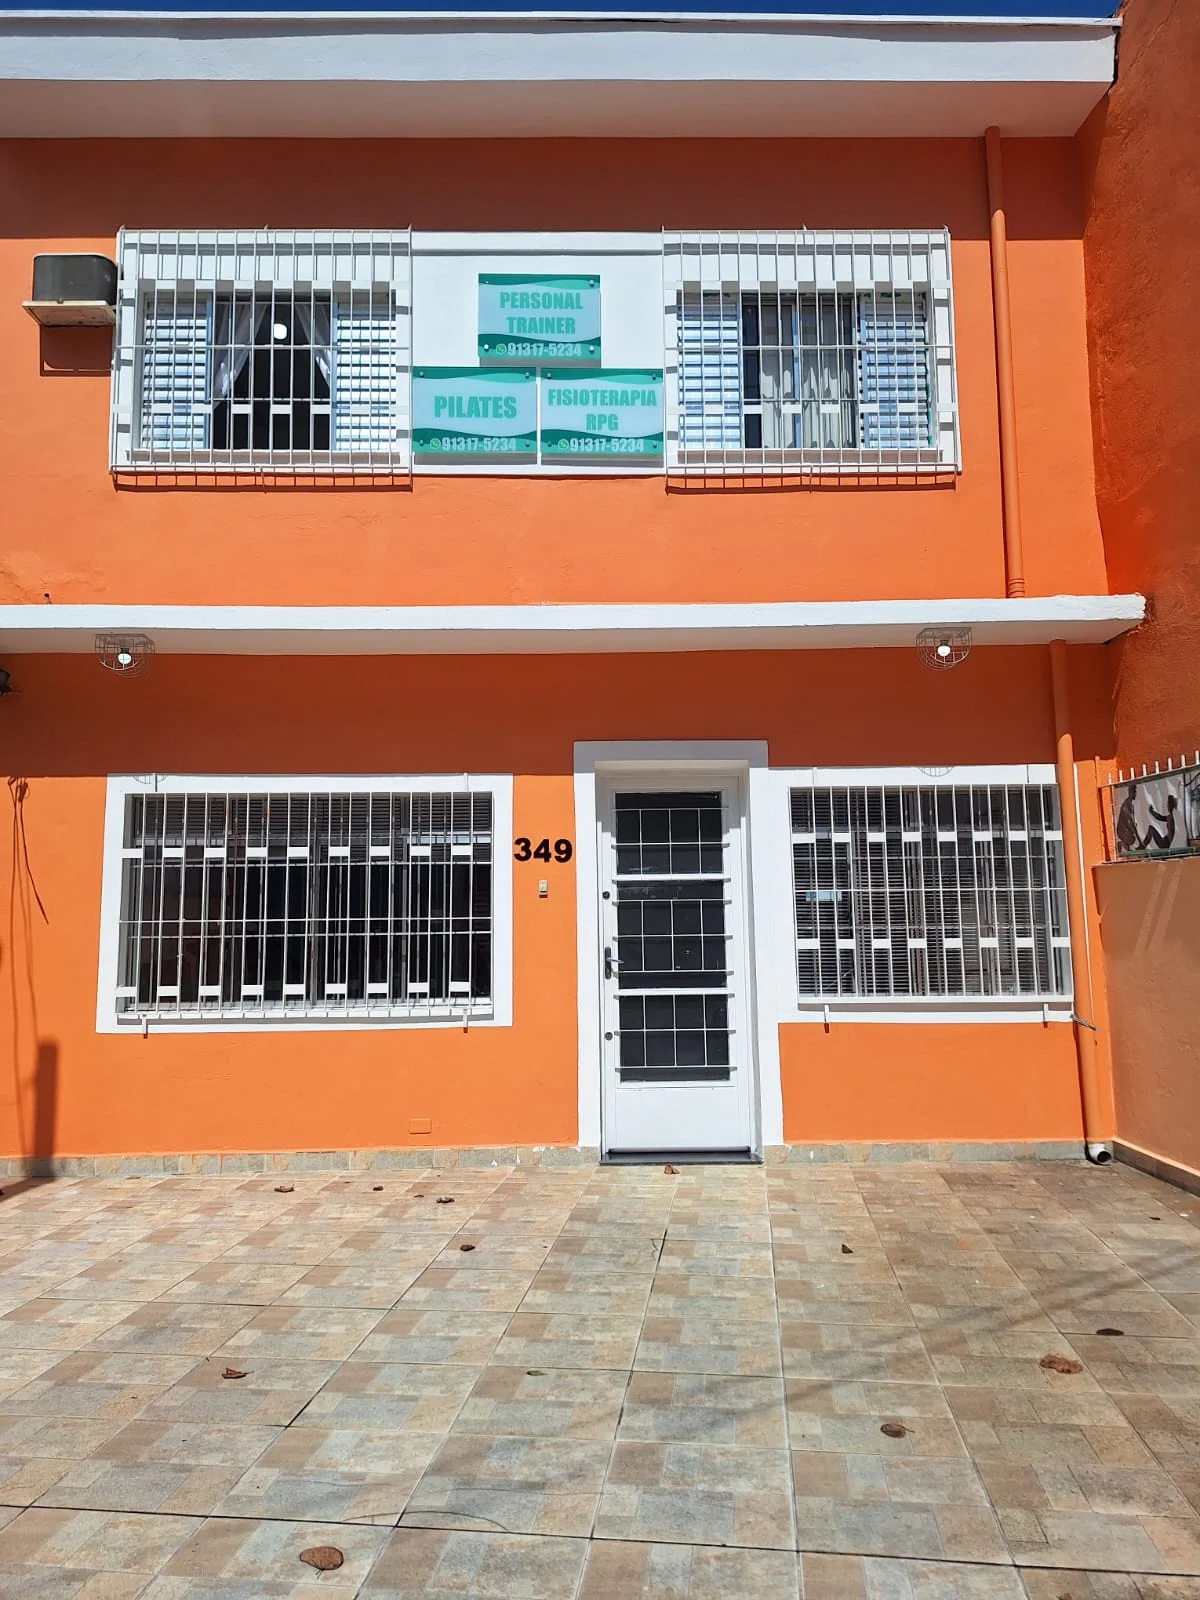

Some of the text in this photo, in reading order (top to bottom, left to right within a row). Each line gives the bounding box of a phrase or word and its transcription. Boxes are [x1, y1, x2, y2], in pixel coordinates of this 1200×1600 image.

[500, 292, 583, 310] PERSONAL
[506, 317, 576, 334] TRAINER
[508, 342, 582, 357] 91317-5234
[548, 389, 657, 406] FISIOTERAPIA
[434, 396, 517, 419] PILATES
[586, 413, 619, 431] RPG
[441, 437, 517, 451] 91317-5234
[570, 438, 644, 452] 91317-5234
[514, 837, 573, 863] 349
